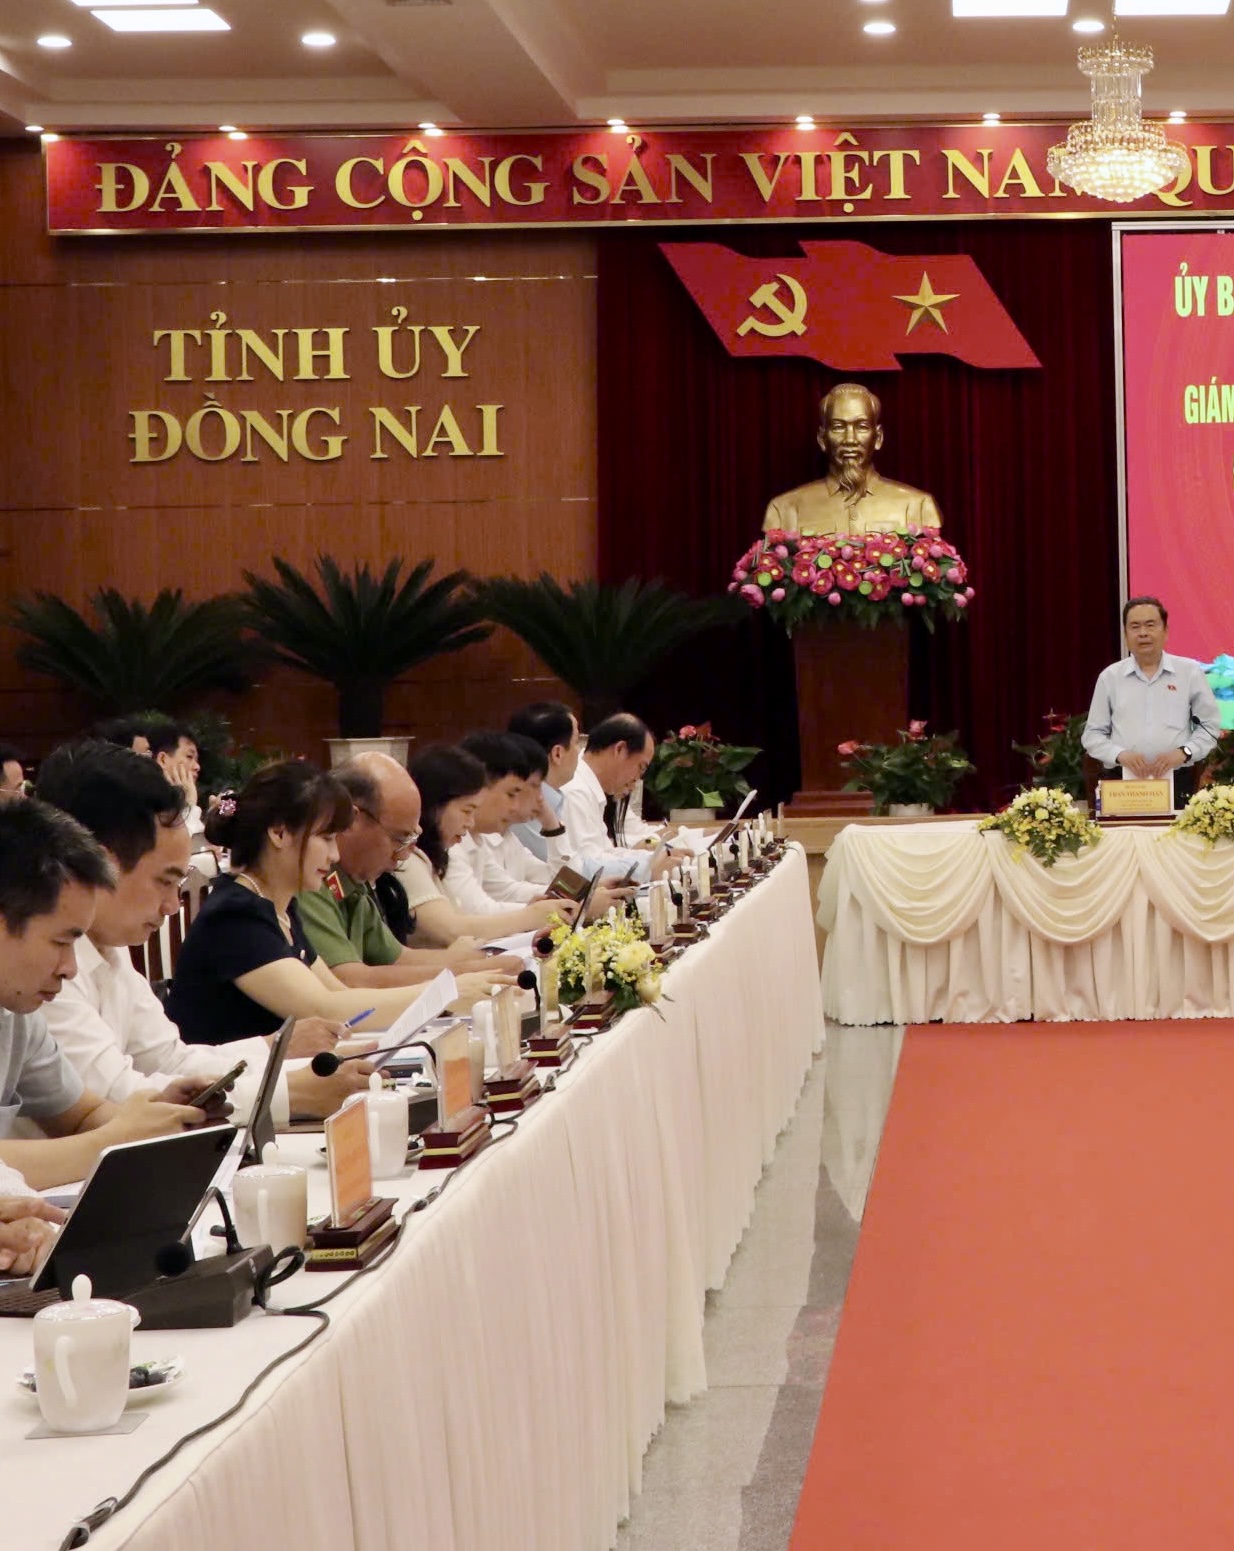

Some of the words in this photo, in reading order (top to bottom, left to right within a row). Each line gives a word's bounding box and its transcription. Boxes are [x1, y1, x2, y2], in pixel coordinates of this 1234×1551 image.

[95, 142, 315, 213] ĐẢNG
[334, 140, 550, 221] CỘNG
[571, 134, 717, 206] SẢN
[738, 132, 921, 213] VIỆT
[941, 147, 1084, 200] NA
[1174, 261, 1210, 318] ỦY
[153, 310, 351, 382] TỈNH
[371, 305, 481, 380] ỦY
[127, 391, 348, 463] ĐỒNG
[368, 404, 504, 460] NAI
